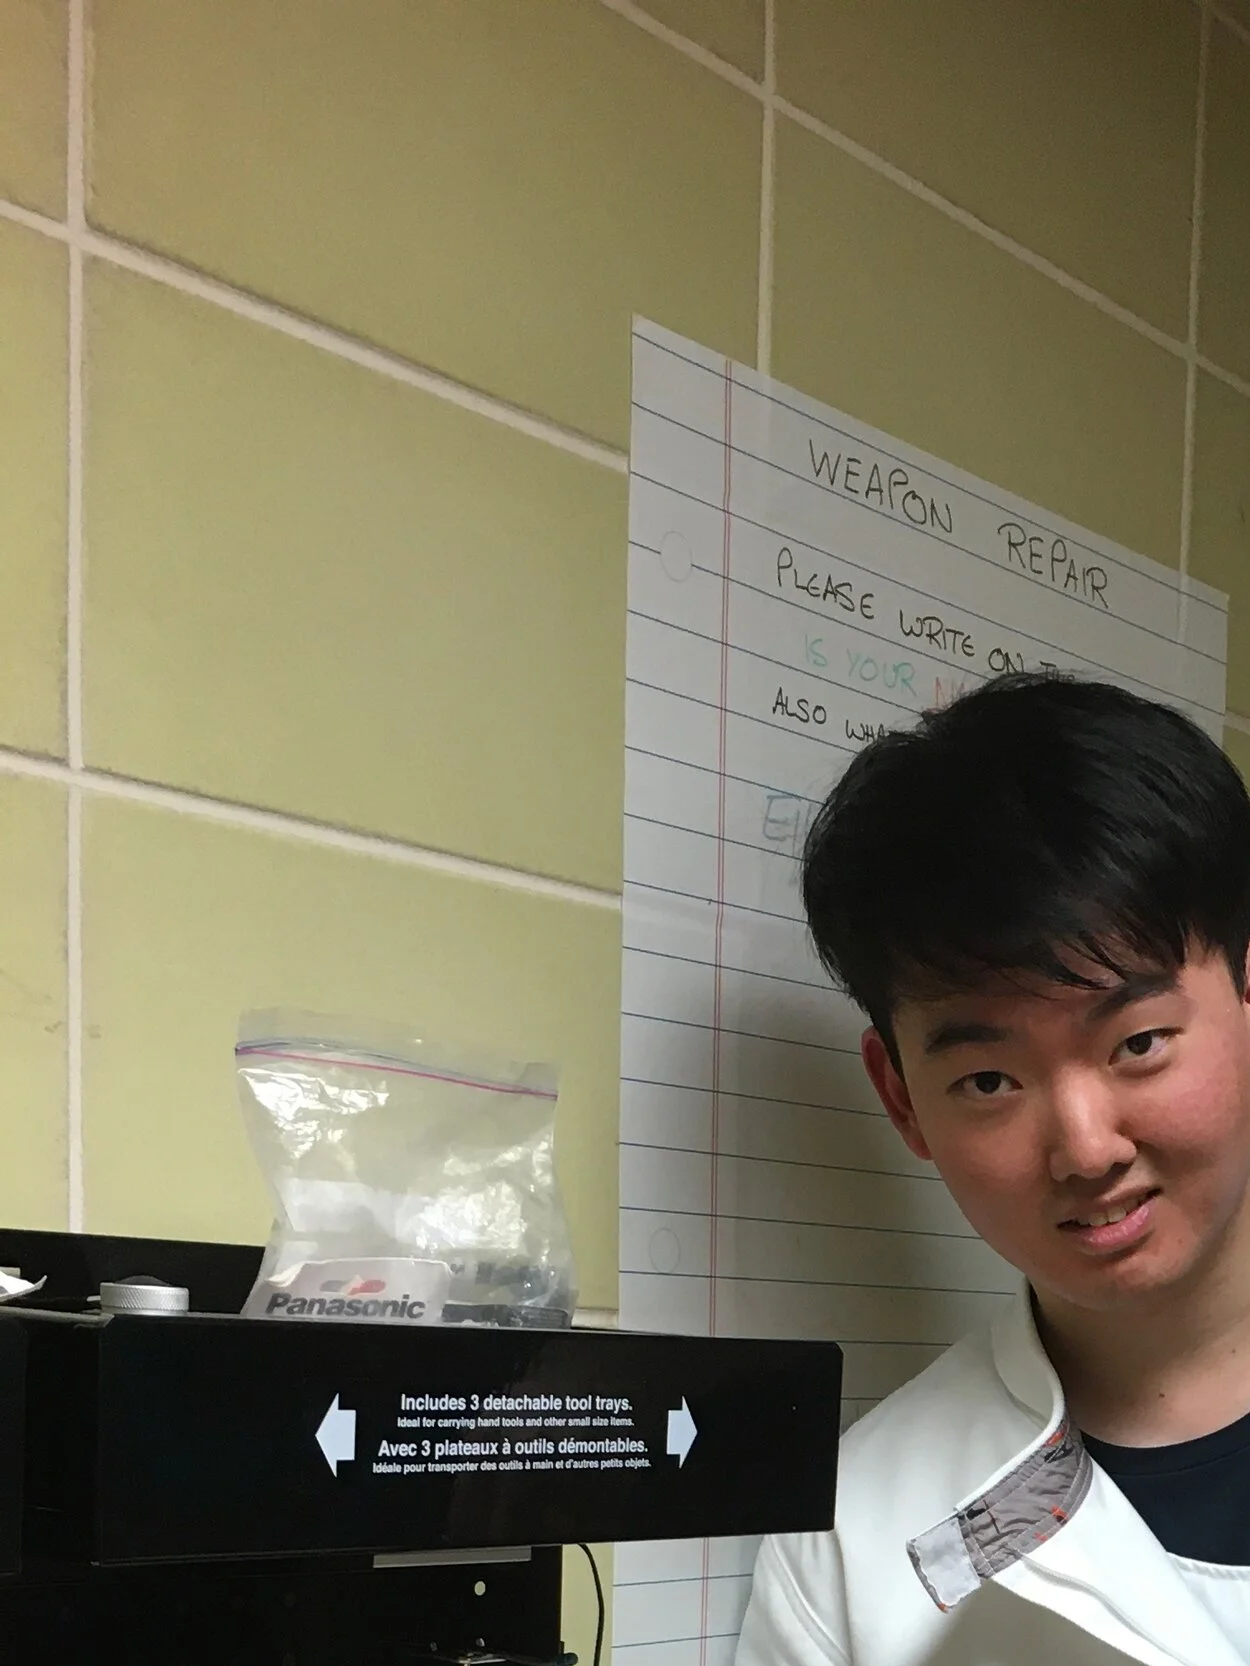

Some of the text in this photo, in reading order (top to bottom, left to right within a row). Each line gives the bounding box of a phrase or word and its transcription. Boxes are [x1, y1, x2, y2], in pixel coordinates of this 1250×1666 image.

[809, 438, 1109, 609] WEAPON REPAIR
[776, 547, 874, 620] PLEASE
[899, 609, 975, 657] WRITE
[988, 647, 1025, 675] ON
[804, 633, 828, 669] IS
[848, 646, 917, 697] YOUR
[772, 686, 827, 725] ALSO
[265, 1292, 426, 1320] Panasonic
[401, 1393, 633, 1414] Includes 3 detachable tool trays.
[397, 1416, 635, 1429] Ideal for carrying hand tools and other small size items.
[378, 1437, 649, 1460] Avec 3 plateaux à outils démontables.
[372, 1457, 652, 1475] Idéale pour transporter des outils à main et d'autres petits objets.
